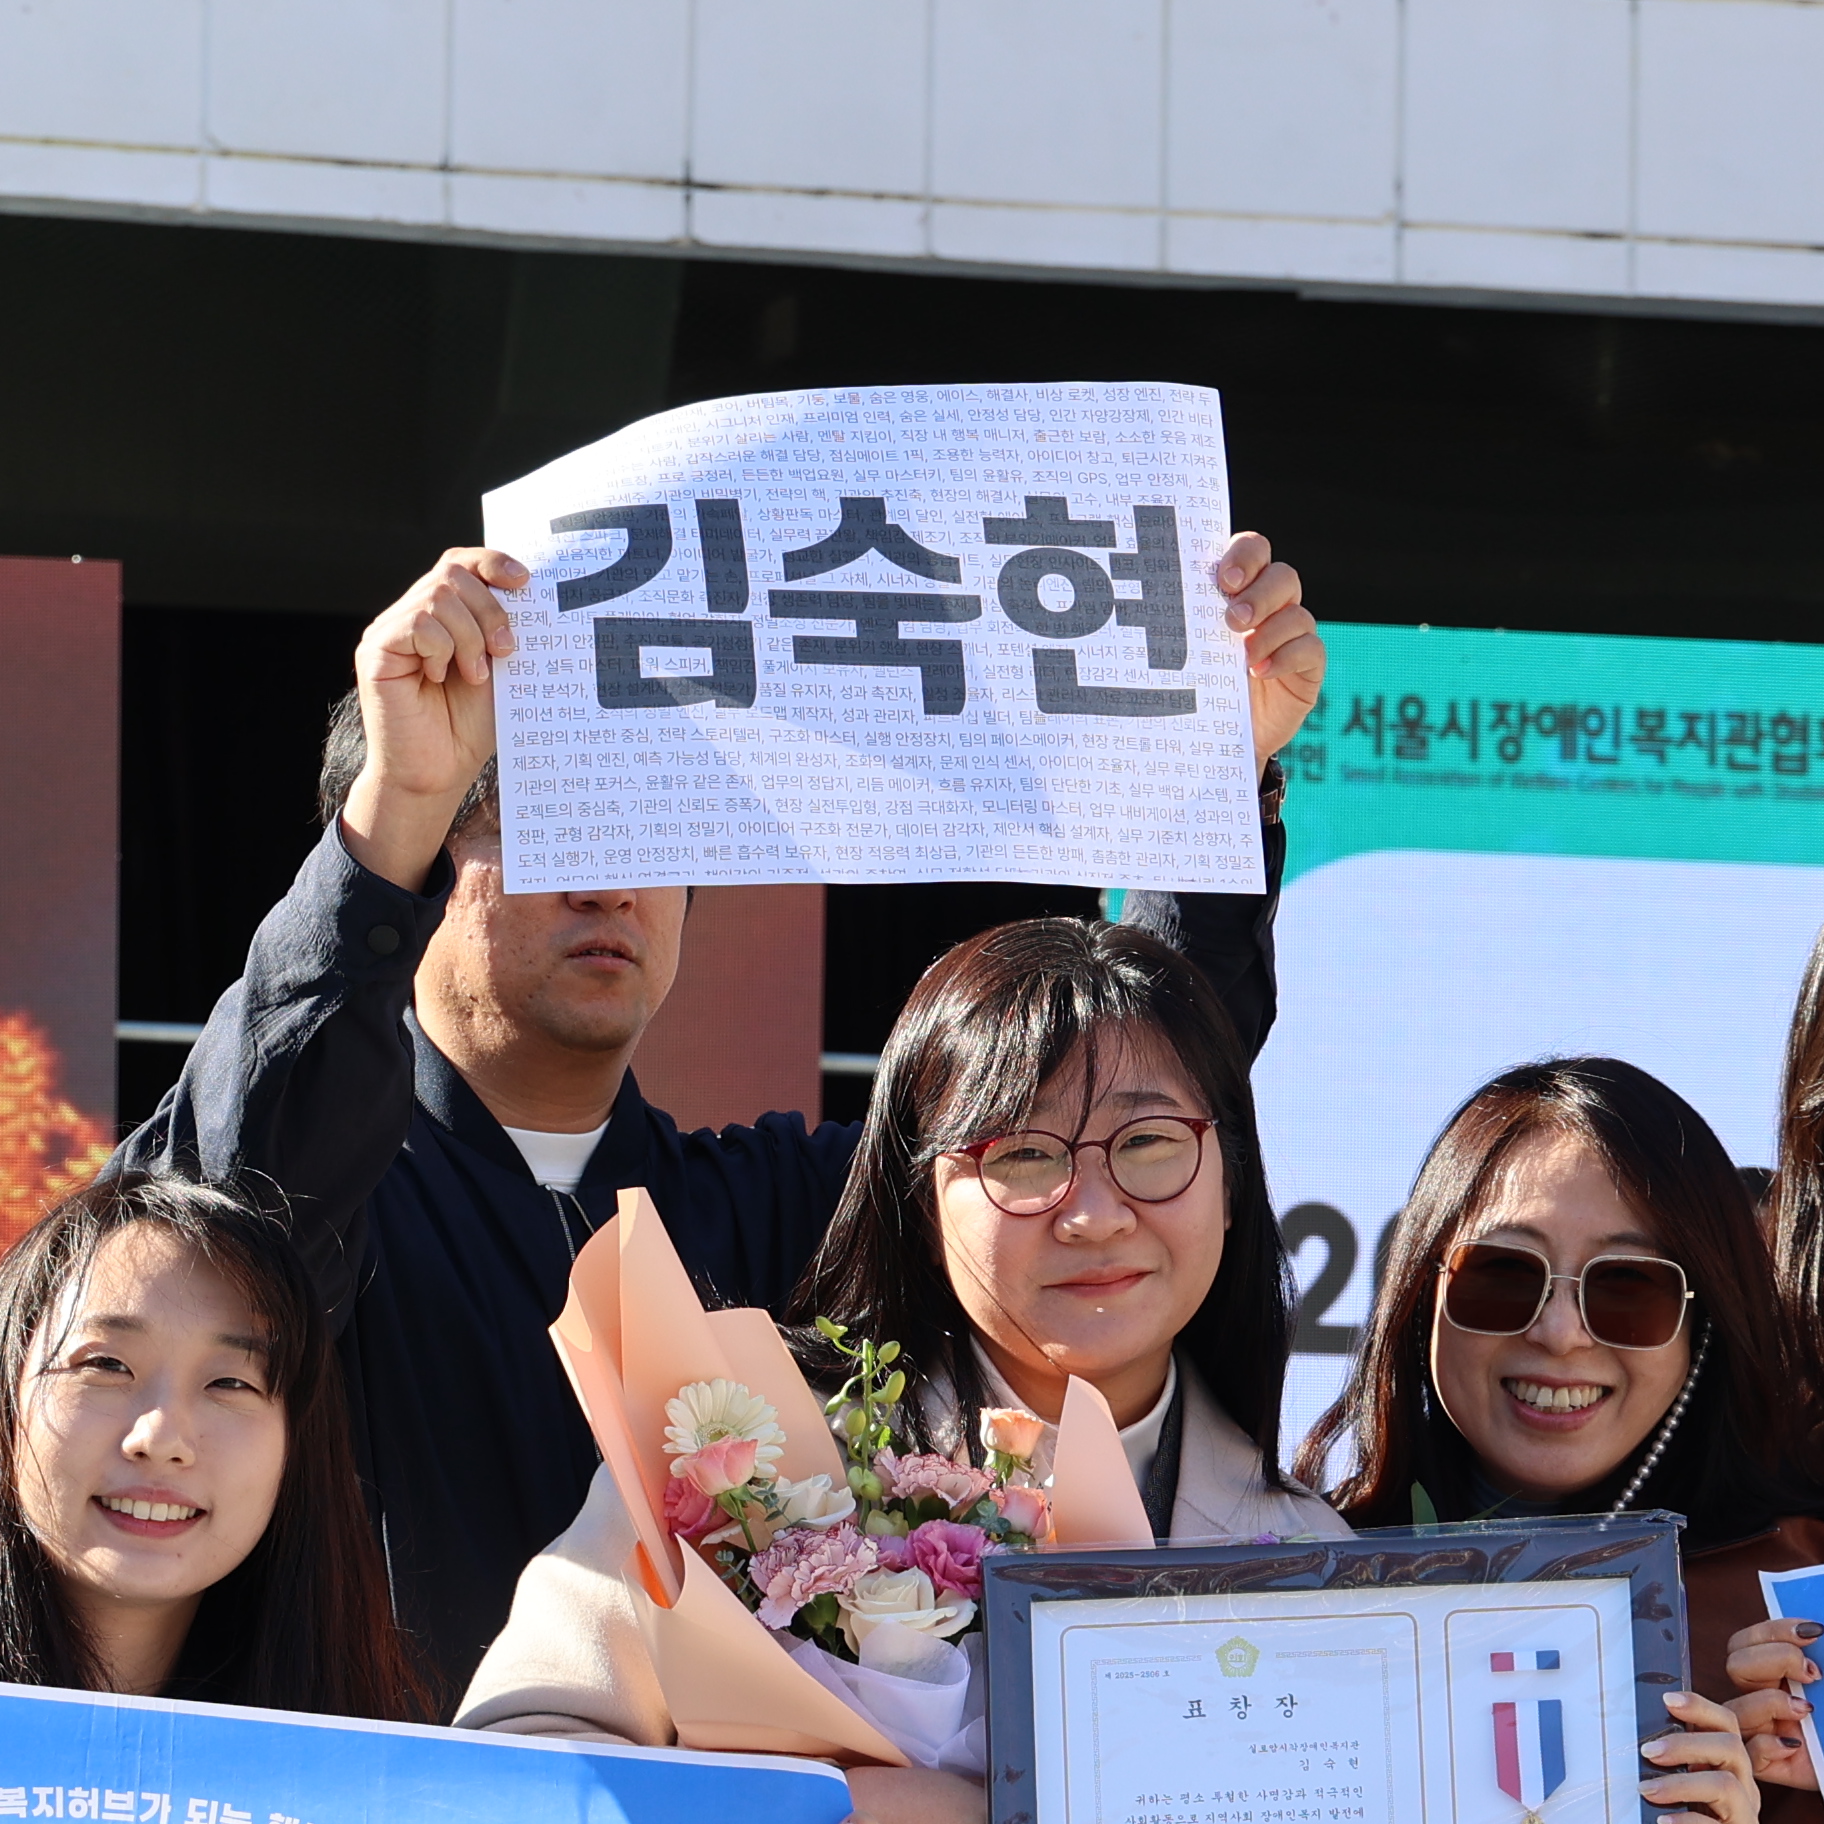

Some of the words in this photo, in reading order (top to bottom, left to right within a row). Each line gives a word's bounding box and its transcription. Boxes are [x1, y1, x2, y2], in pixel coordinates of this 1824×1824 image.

[798, 392, 829, 407] 기둥,
[834, 390, 866, 406] 보물,
[868, 389, 897, 405] 숨은
[901, 390, 933, 404] 영웅,
[937, 388, 982, 406] 에이스,
[987, 388, 1032, 403] 해결사,
[1036, 387, 1063, 402] 비상
[1068, 388, 1098, 404] 로켓,
[1103, 386, 1132, 404] 성장
[1134, 387, 1165, 405] 엔진,
[1169, 389, 1195, 406] 전략
[1198, 392, 1211, 406] 두
[705, 415, 761, 431] 시그니처
[766, 413, 798, 426] 인재,
[804, 411, 858, 424] 프리미엄
[863, 410, 894, 425] 인력,
[899, 410, 927, 423] 숨은
[932, 408, 963, 423] 실세,
[968, 408, 1009, 421] 안정성
[1013, 408, 1045, 424] 담당,
[1049, 408, 1076, 422] 인간
[1081, 408, 1153, 425] 자양강장제,
[1156, 410, 1184, 427] 인간
[1188, 412, 1213, 428] 비타
[735, 432, 779, 446] 살리는
[782, 430, 815, 444] 사람,
[850, 430, 896, 444] 지킴이,
[900, 429, 927, 442] 직장
[933, 429, 947, 442] 내
[951, 428, 979, 442] 행복
[984, 427, 1029, 444] 매니저,
[1033, 429, 1074, 443] 출근한
[1077, 430, 1110, 447] 보람,
[1115, 429, 1156, 444] 소소한
[1158, 430, 1186, 447] 웃음
[1191, 433, 1216, 448] 제조
[686, 450, 757, 466] 갑작스러운
[759, 447, 788, 462] 해결
[793, 449, 824, 464] 담당,
[830, 449, 899, 463] 점심메이트
[903, 449, 928, 463] 1픽,
[932, 448, 974, 461] 조용한
[979, 448, 1023, 466] 능력자,
[1028, 449, 1082, 466] 아이디어
[1087, 451, 1117, 467] 창고,
[1122, 451, 1176, 466] 퇴근시간
[1180, 453, 1217, 469] 지켜주
[548, 494, 1202, 718] 김숙현
[512, 729, 568, 747] 실로암의
[573, 728, 616, 744] 차분한
[621, 727, 653, 745] 중심,
[658, 727, 686, 742] 전략
[690, 727, 764, 746] 스토리텔러,
[769, 727, 812, 745] 구조화
[815, 729, 859, 747] 마스터,
[865, 731, 891, 746] 실행
[895, 731, 955, 749] 안정장치,
[959, 732, 986, 747] 팀의
[991, 732, 1078, 750] 페이스메이커,
[1081, 733, 1108, 751] 현장
[1156, 738, 1185, 757] 타워,
[1187, 739, 1216, 757] 실무
[1218, 742, 1245, 758] 표준
[513, 754, 559, 772] 제조자,
[564, 752, 592, 769] 기획
[597, 751, 629, 769] 엔진,
[633, 751, 662, 766] 예측
[667, 750, 708, 766] 가능성
[714, 750, 745, 768] 담당,
[749, 751, 791, 767] 체계의
[796, 751, 840, 771] 완성자,
[846, 752, 886, 769] 조화의
[890, 754, 935, 772] 설계자,
[940, 755, 968, 770] 문제
[972, 755, 999, 770] 인식
[1004, 755, 1035, 771] 센서,
[1039, 755, 1093, 771] 아이디어
[1097, 758, 1140, 776] 조율자,
[1144, 759, 1172, 776] 실무
[1172, 761, 1199, 779] 루틴
[1203, 764, 1249, 784] 안정자,
[519, 852, 546, 868] 도적
[552, 849, 598, 868] 실행가,
[604, 848, 631, 865] 운영
[637, 846, 698, 863] 안정장치,
[703, 845, 732, 861] 빠른
[737, 844, 779, 860] 흡수력
[785, 845, 830, 862] 보유자,
[835, 845, 863, 860] 현장
[866, 844, 910, 861] 적응력
[915, 845, 961, 861] 최상급,
[966, 842, 1007, 859] 기관의
[1013, 845, 1053, 860] 든든한
[1057, 845, 1087, 864] 방패,
[1092, 848, 1132, 866] 촘촘한
[1136, 852, 1179, 870] 관리자,
[1184, 854, 1210, 869] 기획
[1215, 855, 1256, 870] 정밀조
[1248, 1741, 1359, 1753] 실로암시각장애인복지관
[1135, 1793, 1173, 1805] 귀하는
[1180, 1792, 1204, 1804] 평소
[1211, 1790, 1249, 1802] 투철한
[1256, 1789, 1307, 1801] 사명감과
[1314, 1786, 1363, 1799] 적극적인
[1205, 1811, 1253, 1824] 지역사회
[1260, 1809, 1321, 1822] 장애인복지
[1329, 1807, 1364, 1819] 발전에
